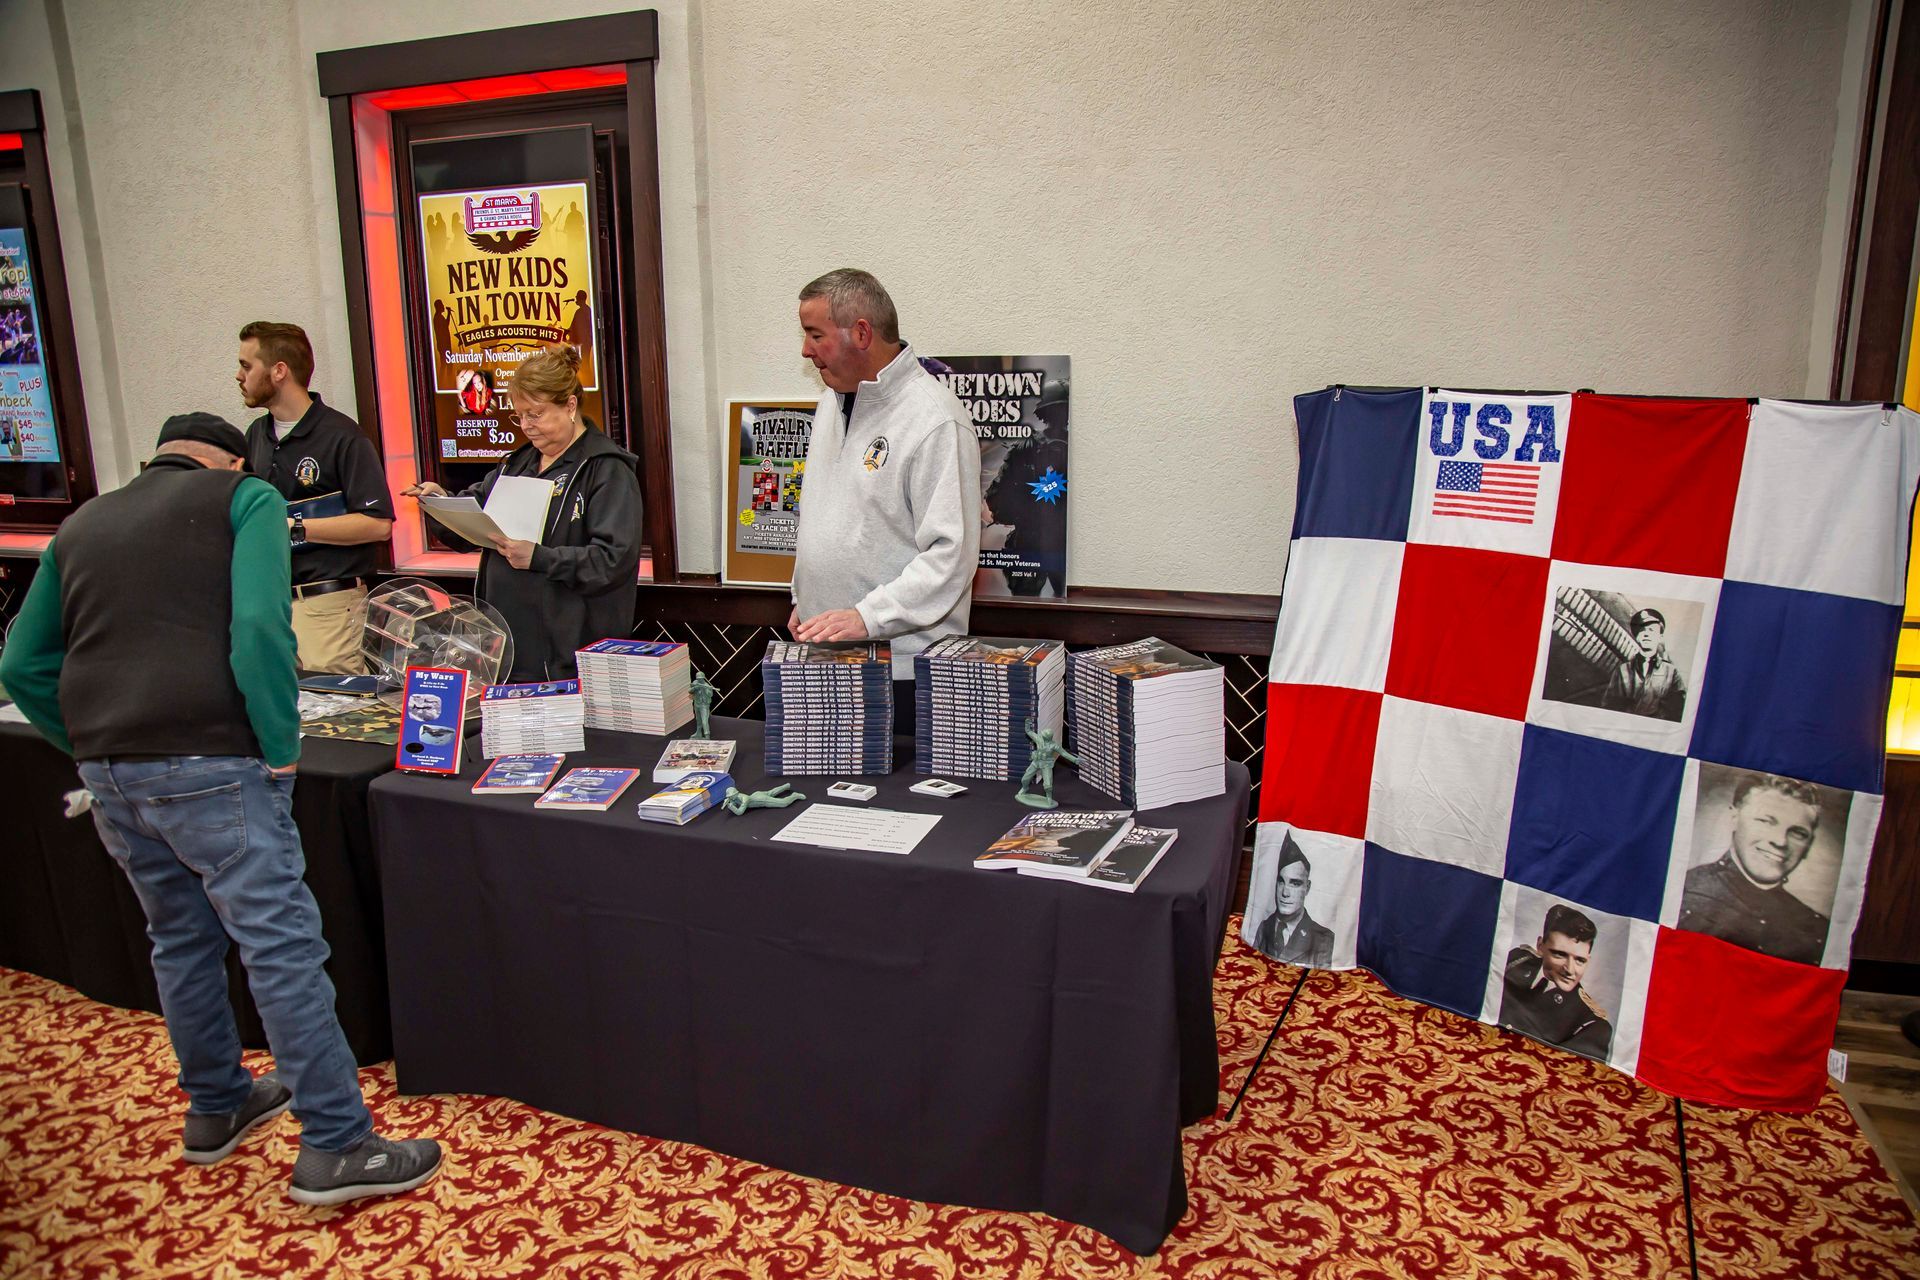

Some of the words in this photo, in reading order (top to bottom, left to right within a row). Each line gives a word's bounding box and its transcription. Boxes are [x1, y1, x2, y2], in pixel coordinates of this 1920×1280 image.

[495, 198, 517, 206] MARYS
[447, 258, 501, 294] NEW
[507, 257, 568, 288] KIDS
[456, 295, 480, 326] IN
[486, 291, 561, 321] TOWN
[466, 329, 494, 342] EAGLES
[497, 328, 537, 337] ACOUSTIC
[540, 330, 558, 340] HITS
[446, 349, 483, 366] Saturday
[485, 347, 530, 362] November
[753, 418, 812, 436] RIVALRY
[998, 425, 1032, 437] OHIO
[1429, 402, 1560, 462] USA
[489, 428, 514, 444] $20
[756, 441, 809, 458] RAFFLE
[1043, 481, 1057, 492] $25
[416, 672, 429, 680] My
